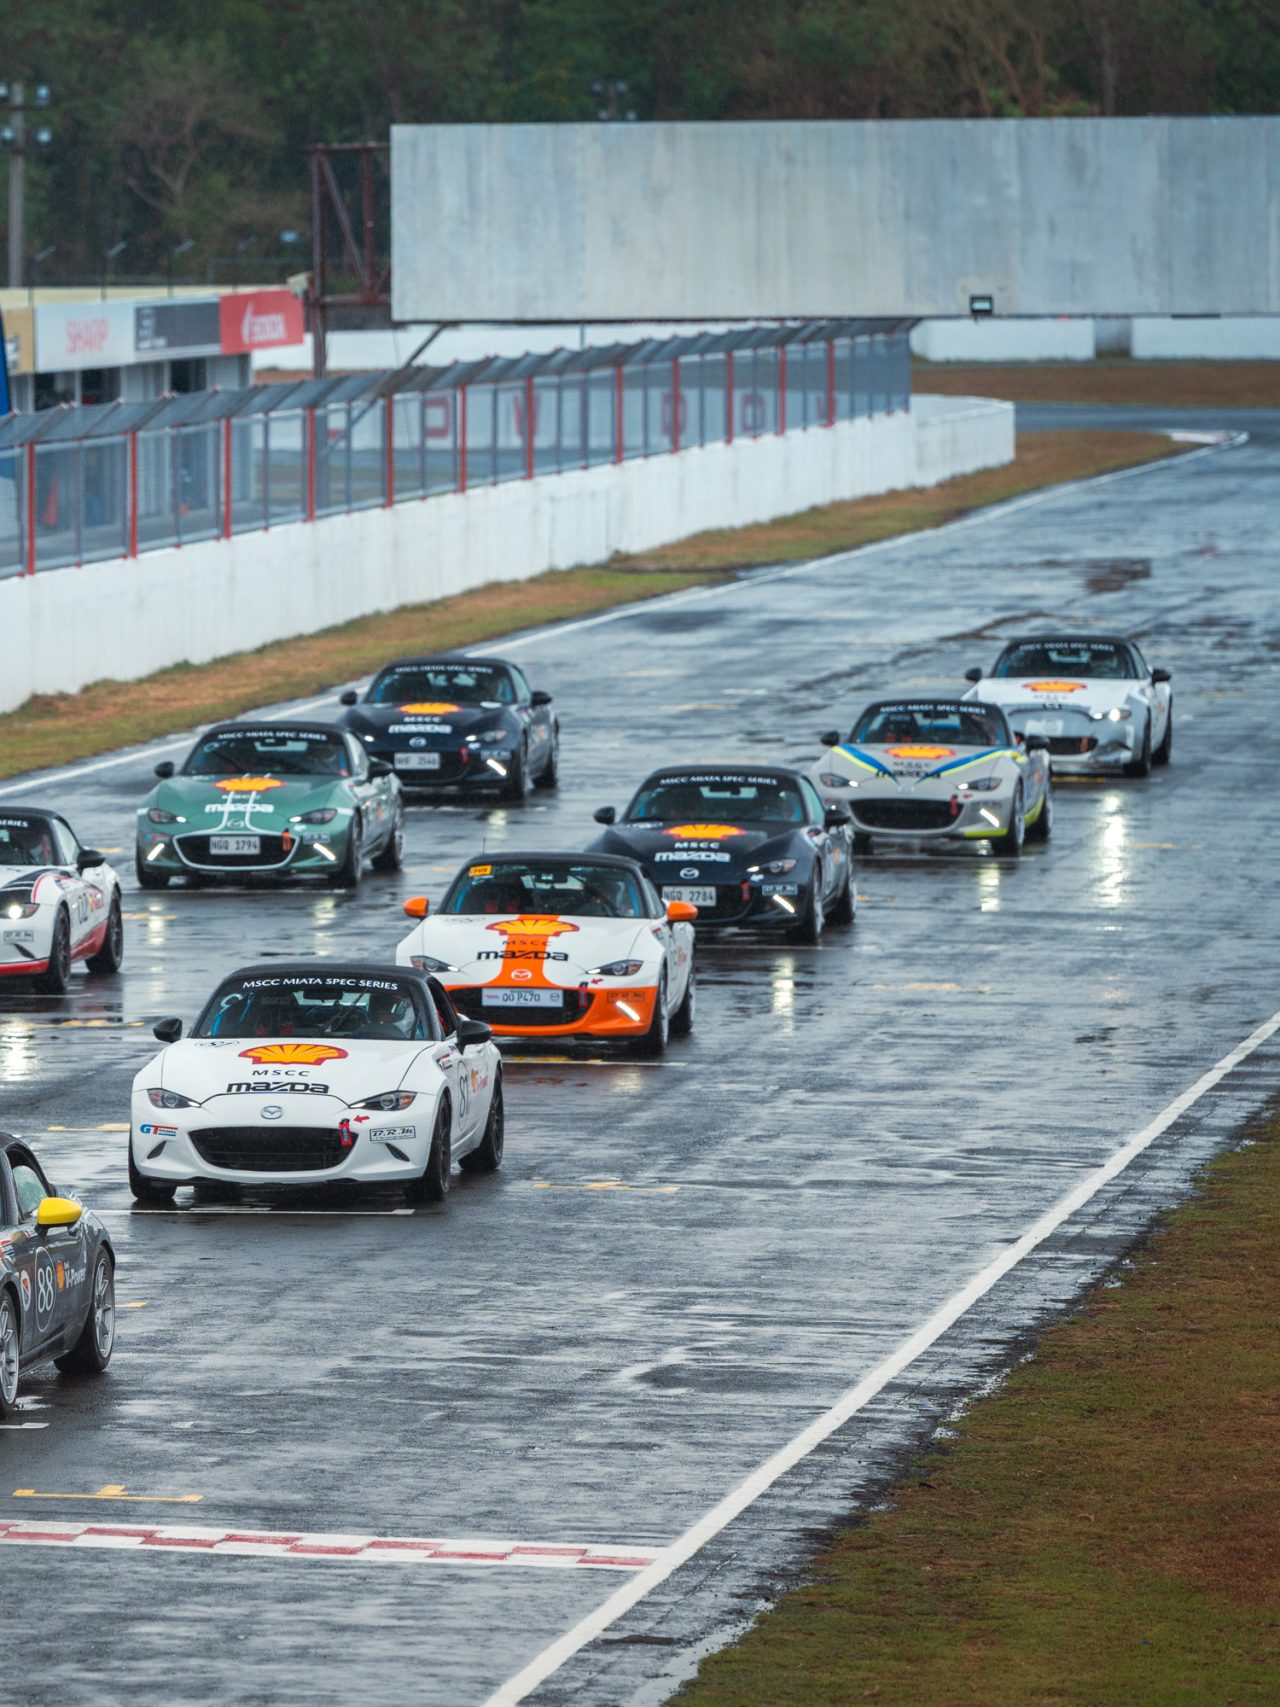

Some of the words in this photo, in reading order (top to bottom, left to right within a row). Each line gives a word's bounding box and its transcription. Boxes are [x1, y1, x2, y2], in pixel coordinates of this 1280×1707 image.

[242, 979, 280, 989] MSCC
[282, 977, 322, 985] MIATA
[325, 977, 357, 986] SPEC
[358, 979, 399, 991] SERIES
[251, 1069, 310, 1077] MSCC
[37, 1265, 54, 1314] 88
